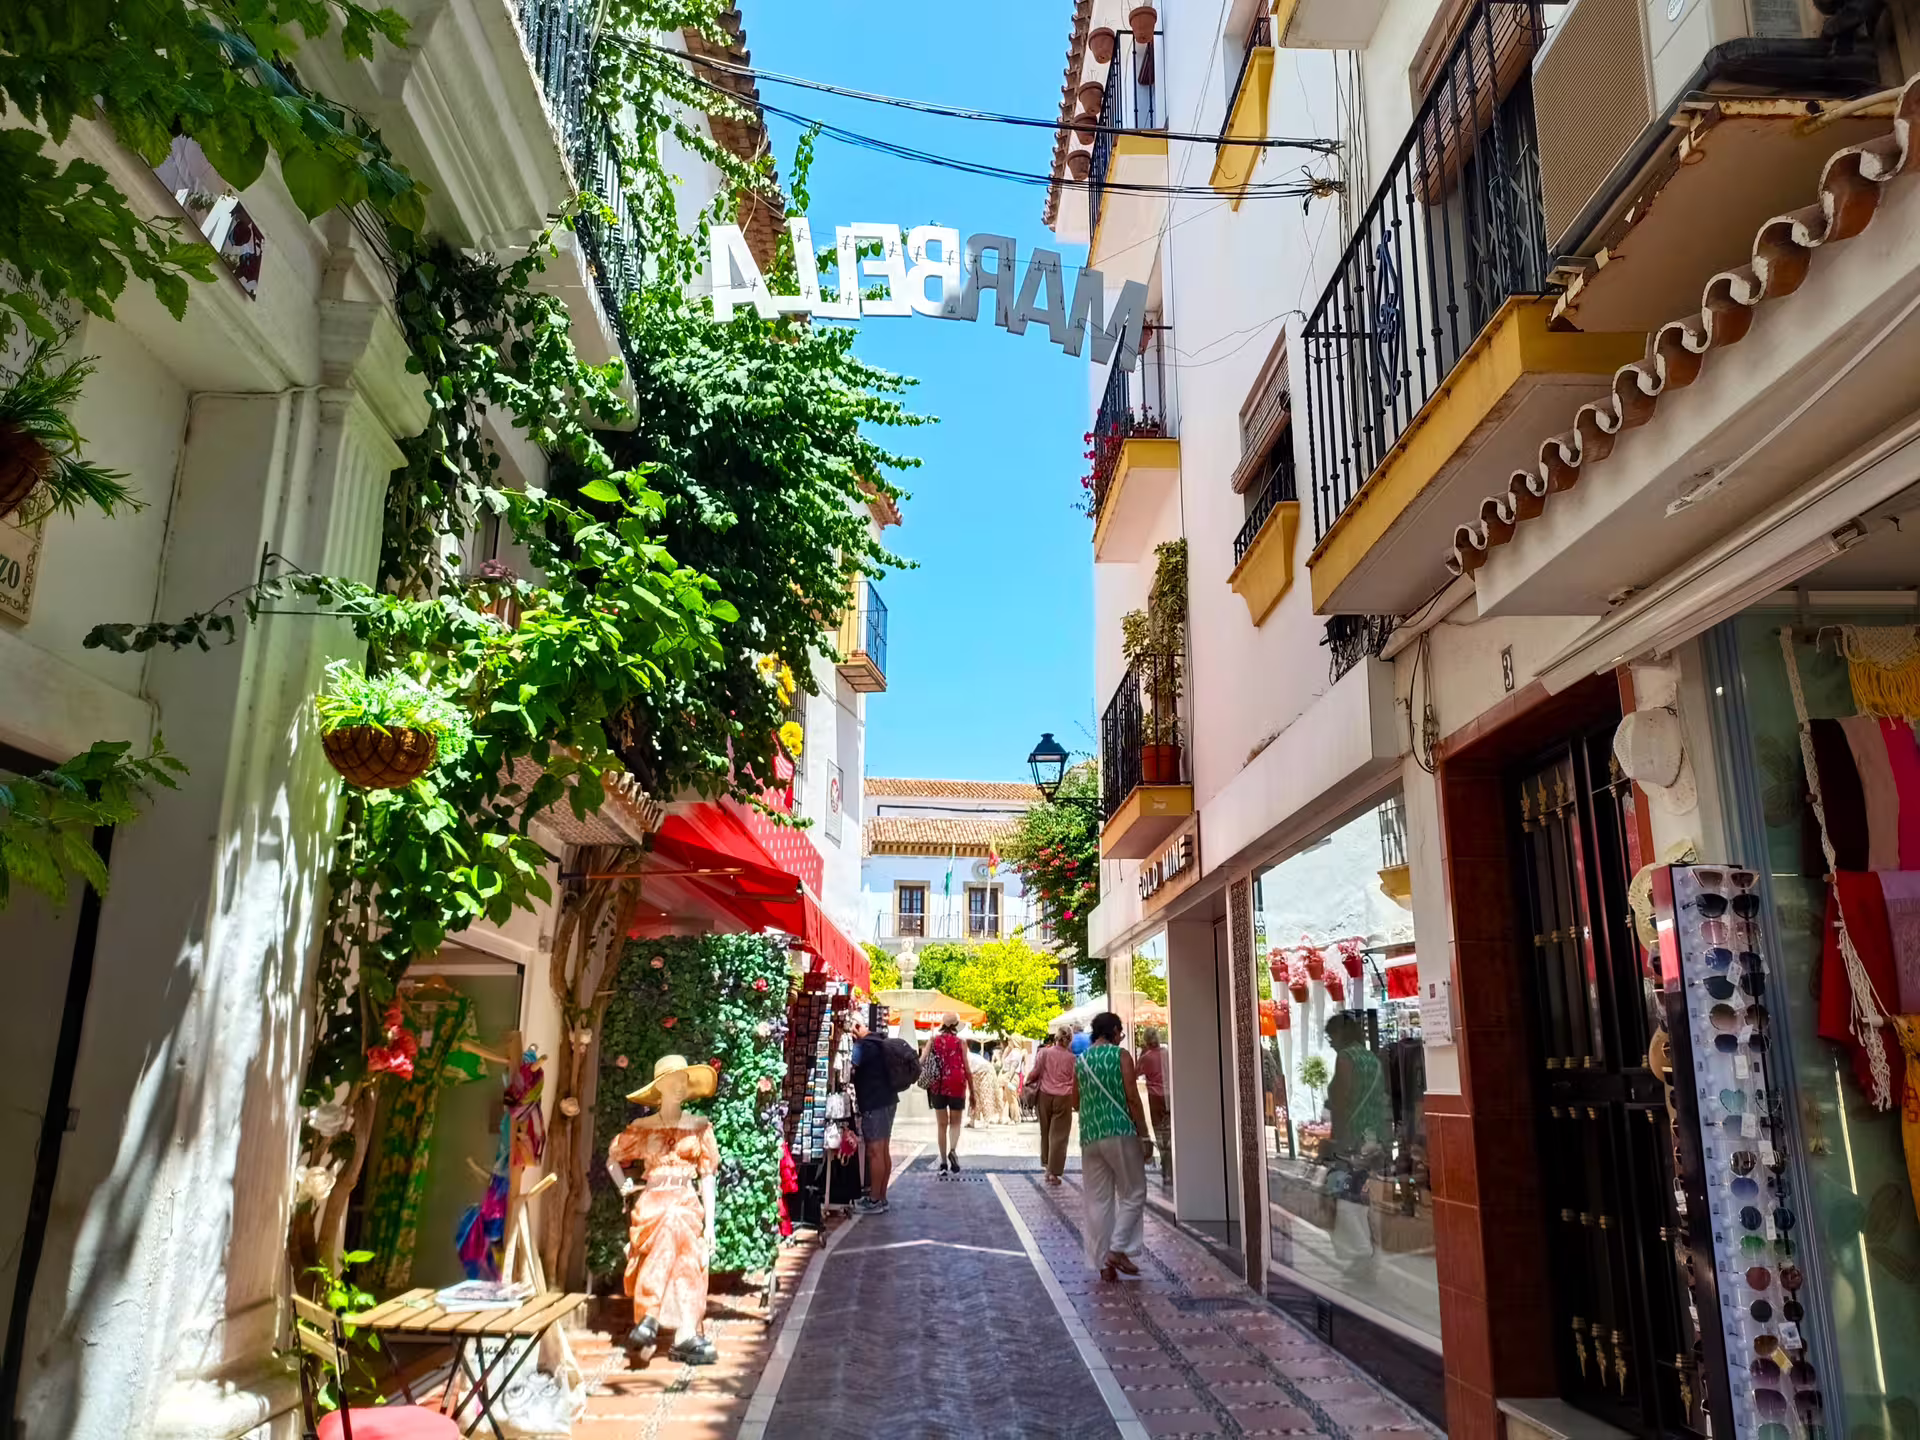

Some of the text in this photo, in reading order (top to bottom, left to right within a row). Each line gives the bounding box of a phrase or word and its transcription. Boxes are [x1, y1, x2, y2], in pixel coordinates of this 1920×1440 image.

[1503, 654, 1513, 689] 3
[1138, 835, 1190, 900] GOLD MINE
